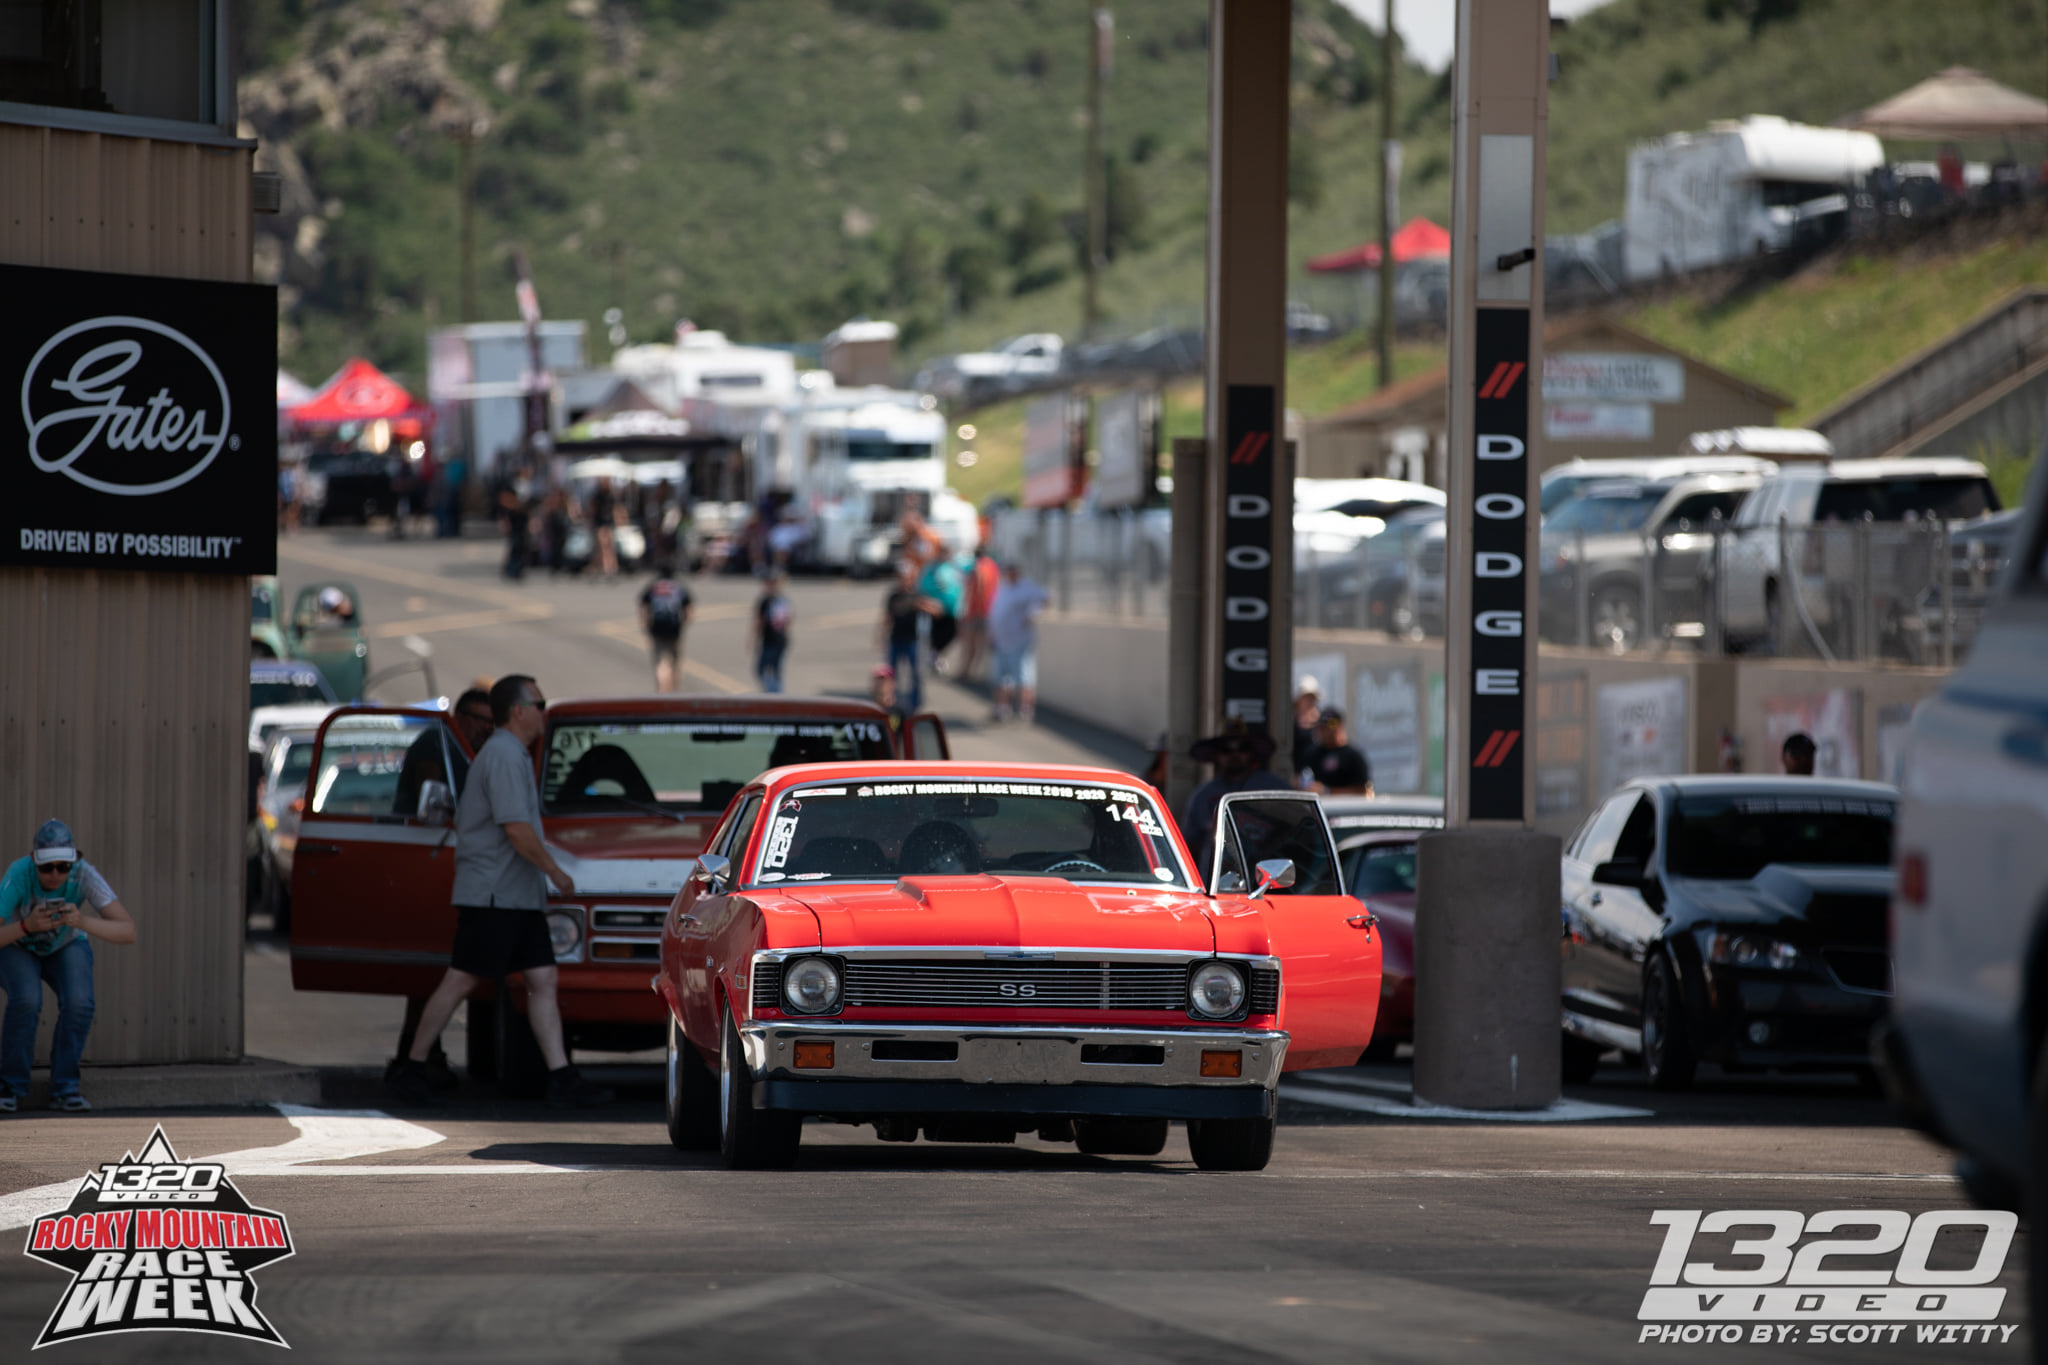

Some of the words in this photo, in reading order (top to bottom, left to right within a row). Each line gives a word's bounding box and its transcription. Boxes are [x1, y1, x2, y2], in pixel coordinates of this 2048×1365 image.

[29, 340, 218, 472] Gates
[20, 528, 90, 553] DRIVEN
[95, 532, 119, 554] BY
[123, 533, 234, 558] POSSIBILITY
[1474, 434, 1526, 695] DODGE
[1225, 494, 1271, 723] DODGE
[841, 723, 882, 742] 176
[874, 784, 915, 796] ROCKY
[916, 784, 977, 794] MOUNTAIN
[978, 784, 1009, 795] RACE
[1009, 785, 1043, 796] WEEK
[1106, 804, 1156, 828] 144
[771, 816, 799, 868] 1320
[1000, 983, 1036, 997] SS
